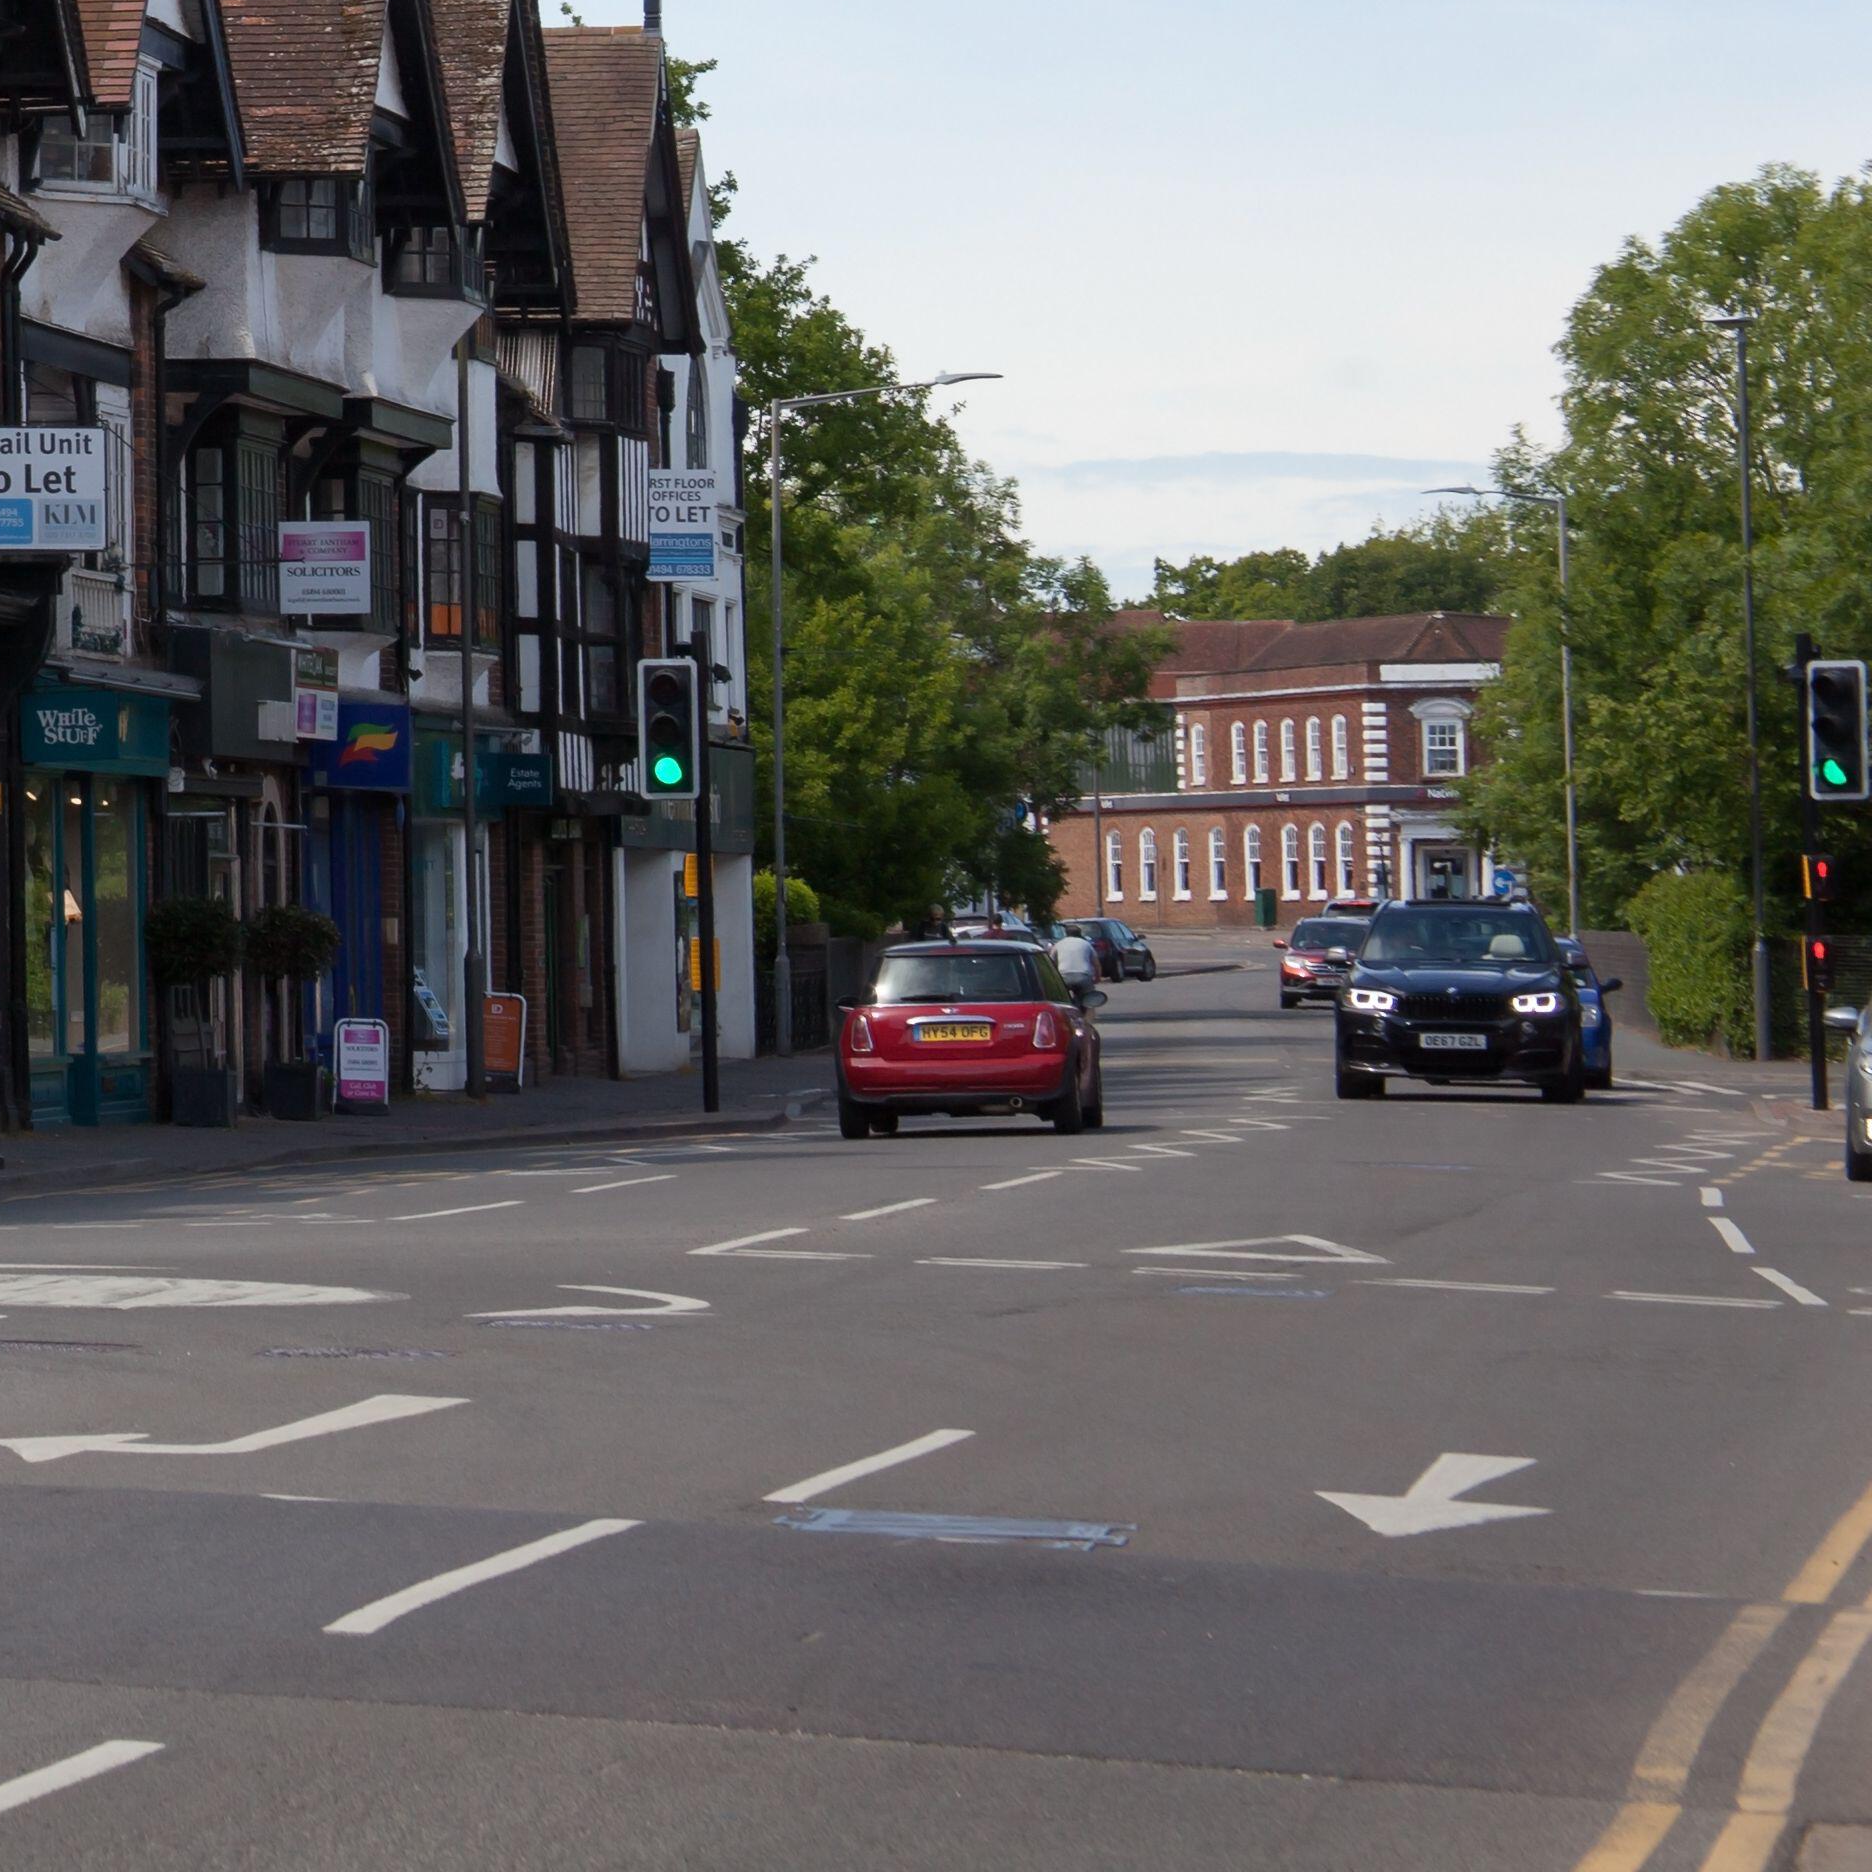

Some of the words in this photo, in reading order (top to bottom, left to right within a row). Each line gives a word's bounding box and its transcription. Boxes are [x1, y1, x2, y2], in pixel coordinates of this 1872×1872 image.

[40, 432, 93, 455] Unit
[24, 464, 77, 494] Let
[649, 478, 671, 488] RST
[674, 478, 715, 488] FLOOR
[652, 491, 701, 501] OFFICES
[45, 504, 96, 525] KLM
[649, 506, 670, 522] TO
[676, 506, 710, 522] LET
[650, 535, 711, 550] arringtons
[287, 566, 361, 577] SOLICITORS
[510, 768, 540, 778] Estate
[507, 778, 542, 790] Agents
[922, 1026, 956, 1038] HY54
[961, 1025, 988, 1038] OFG
